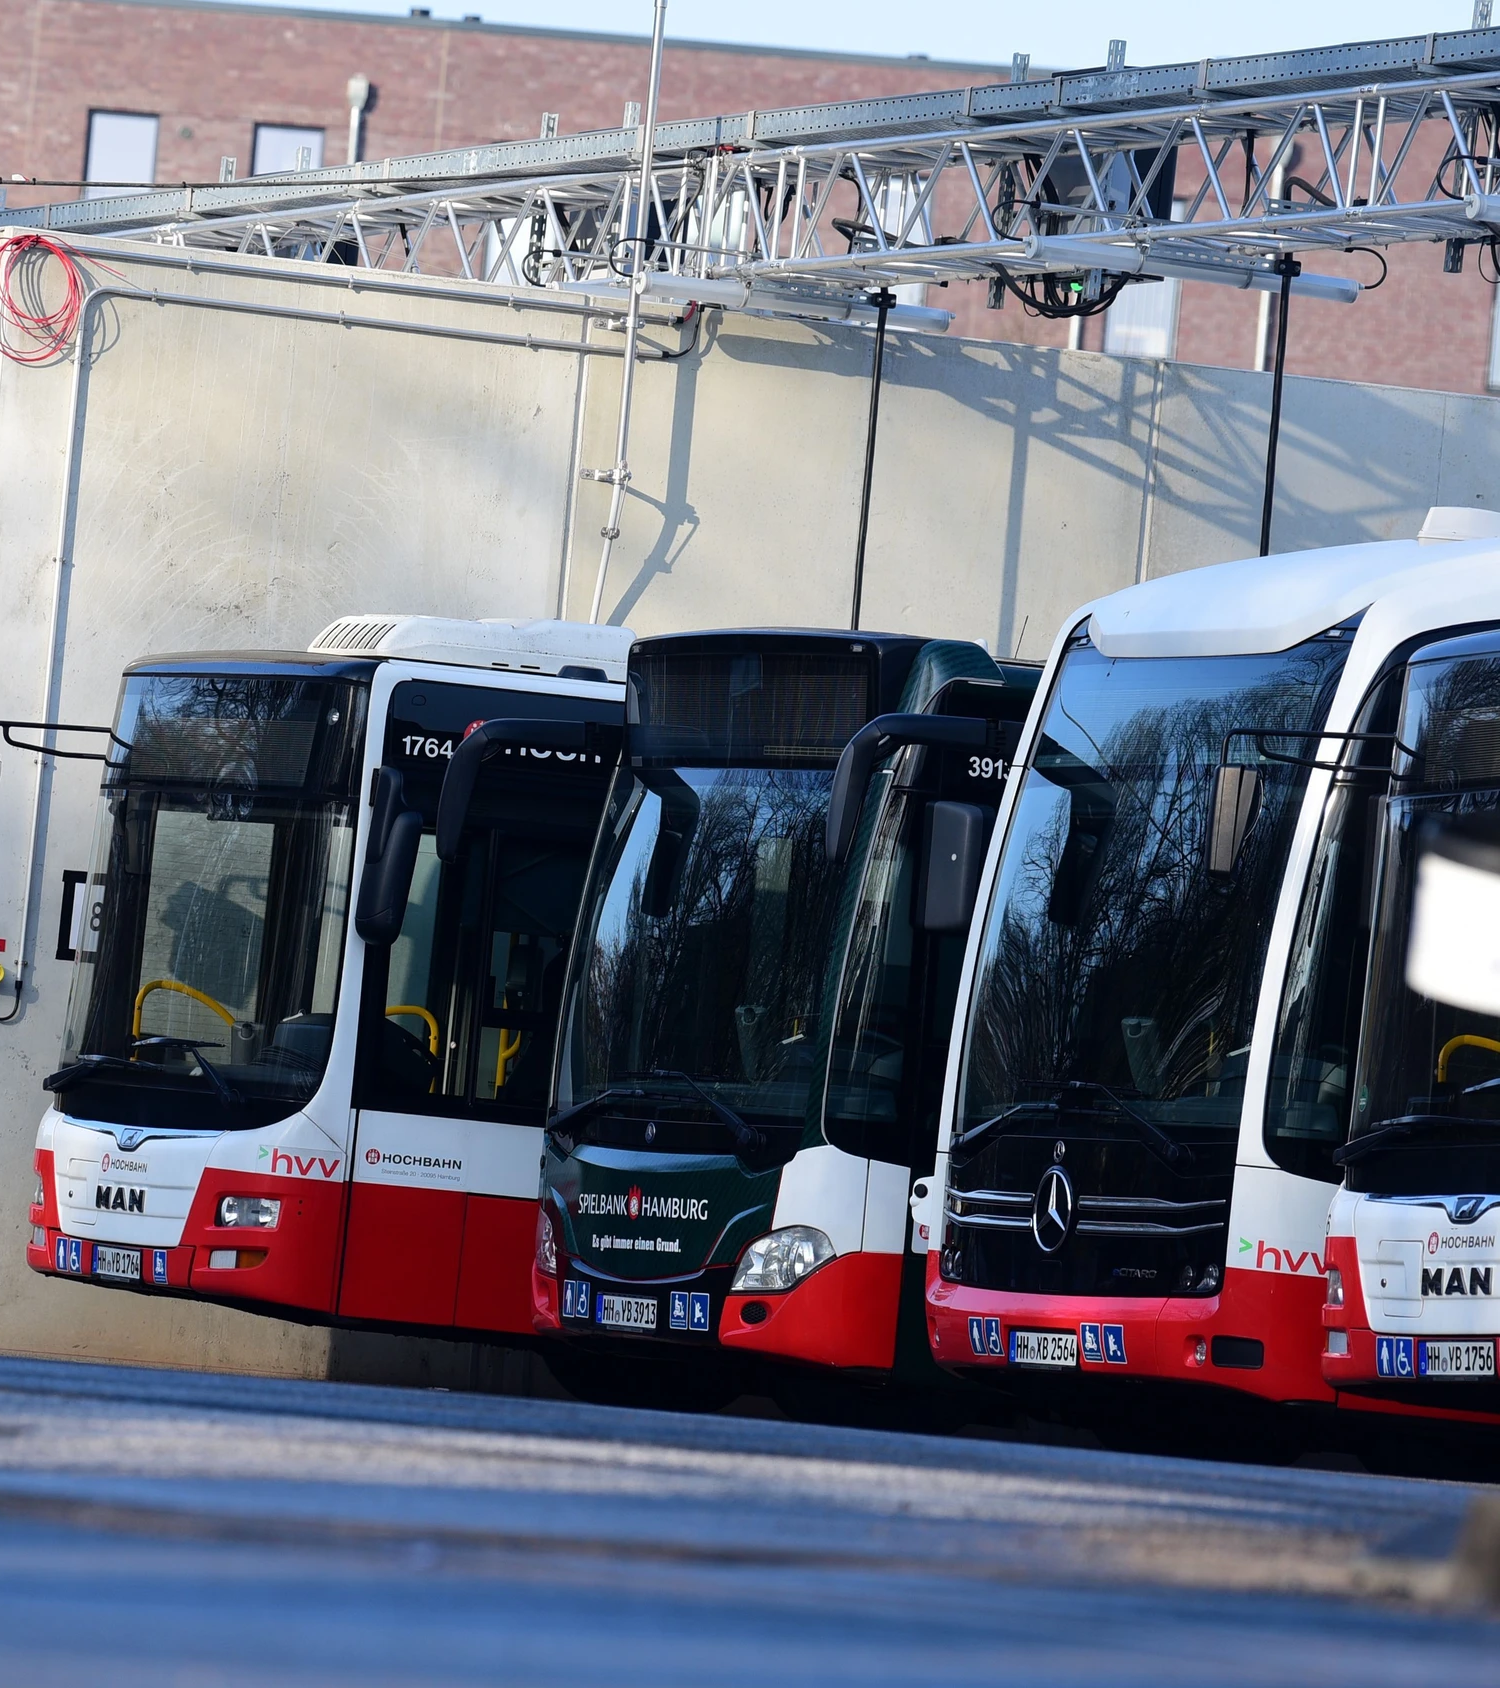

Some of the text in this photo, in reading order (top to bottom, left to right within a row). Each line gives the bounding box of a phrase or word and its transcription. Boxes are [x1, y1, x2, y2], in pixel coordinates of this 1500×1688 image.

[402, 736, 454, 759] 1764
[110, 1159, 148, 1173] HOCHBAHN
[271, 1148, 340, 1178] hvv
[382, 1153, 462, 1170] HOCHBAHN
[437, 1174, 460, 1182] Hamburg
[96, 1185, 146, 1213] MAN
[578, 1193, 708, 1220] SPIELBANK HAMBURG
[592, 1234, 682, 1253] Es gibt immer einen Grund.
[1440, 1236, 1496, 1249] HOCHBAHN
[98, 1249, 139, 1276] HH YB 1764
[1256, 1240, 1328, 1276] hvv
[1421, 1267, 1493, 1296] MAN
[603, 1298, 614, 1322] HH
[622, 1300, 632, 1322] YB
[634, 1301, 656, 1325] 3913
[1016, 1336, 1029, 1359] HH
[1036, 1336, 1049, 1360] XB
[1050, 1338, 1075, 1362] 2564
[1427, 1346, 1440, 1371] HH
[1448, 1346, 1462, 1371] YB
[1465, 1346, 1492, 1371] 1756
